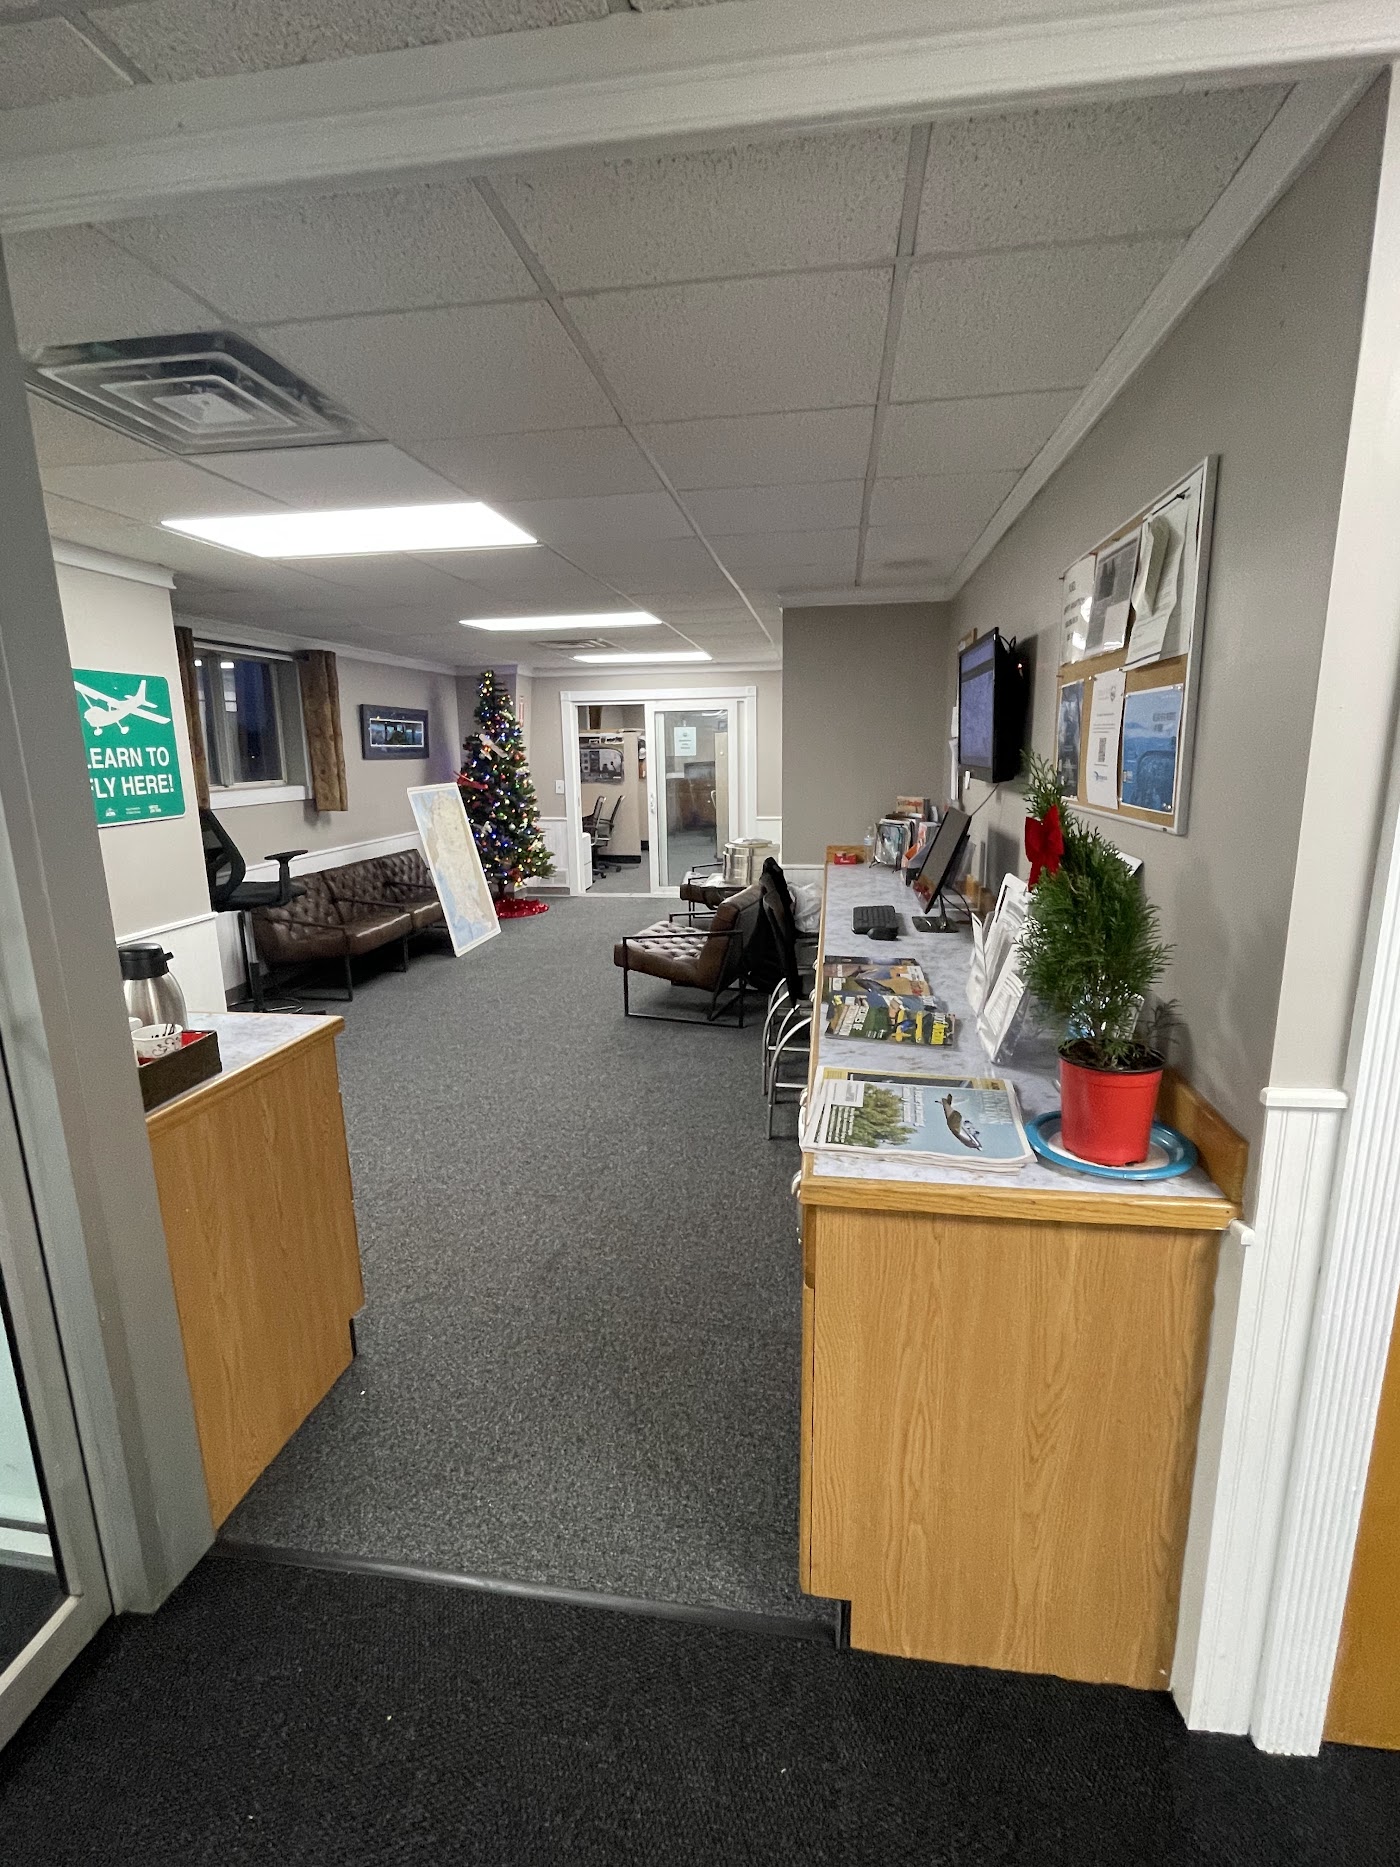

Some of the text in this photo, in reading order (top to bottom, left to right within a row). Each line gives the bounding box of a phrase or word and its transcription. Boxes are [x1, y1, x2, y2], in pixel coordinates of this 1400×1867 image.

[88, 746, 170, 769] EARN TO
[121, 774, 174, 797] HERE!
